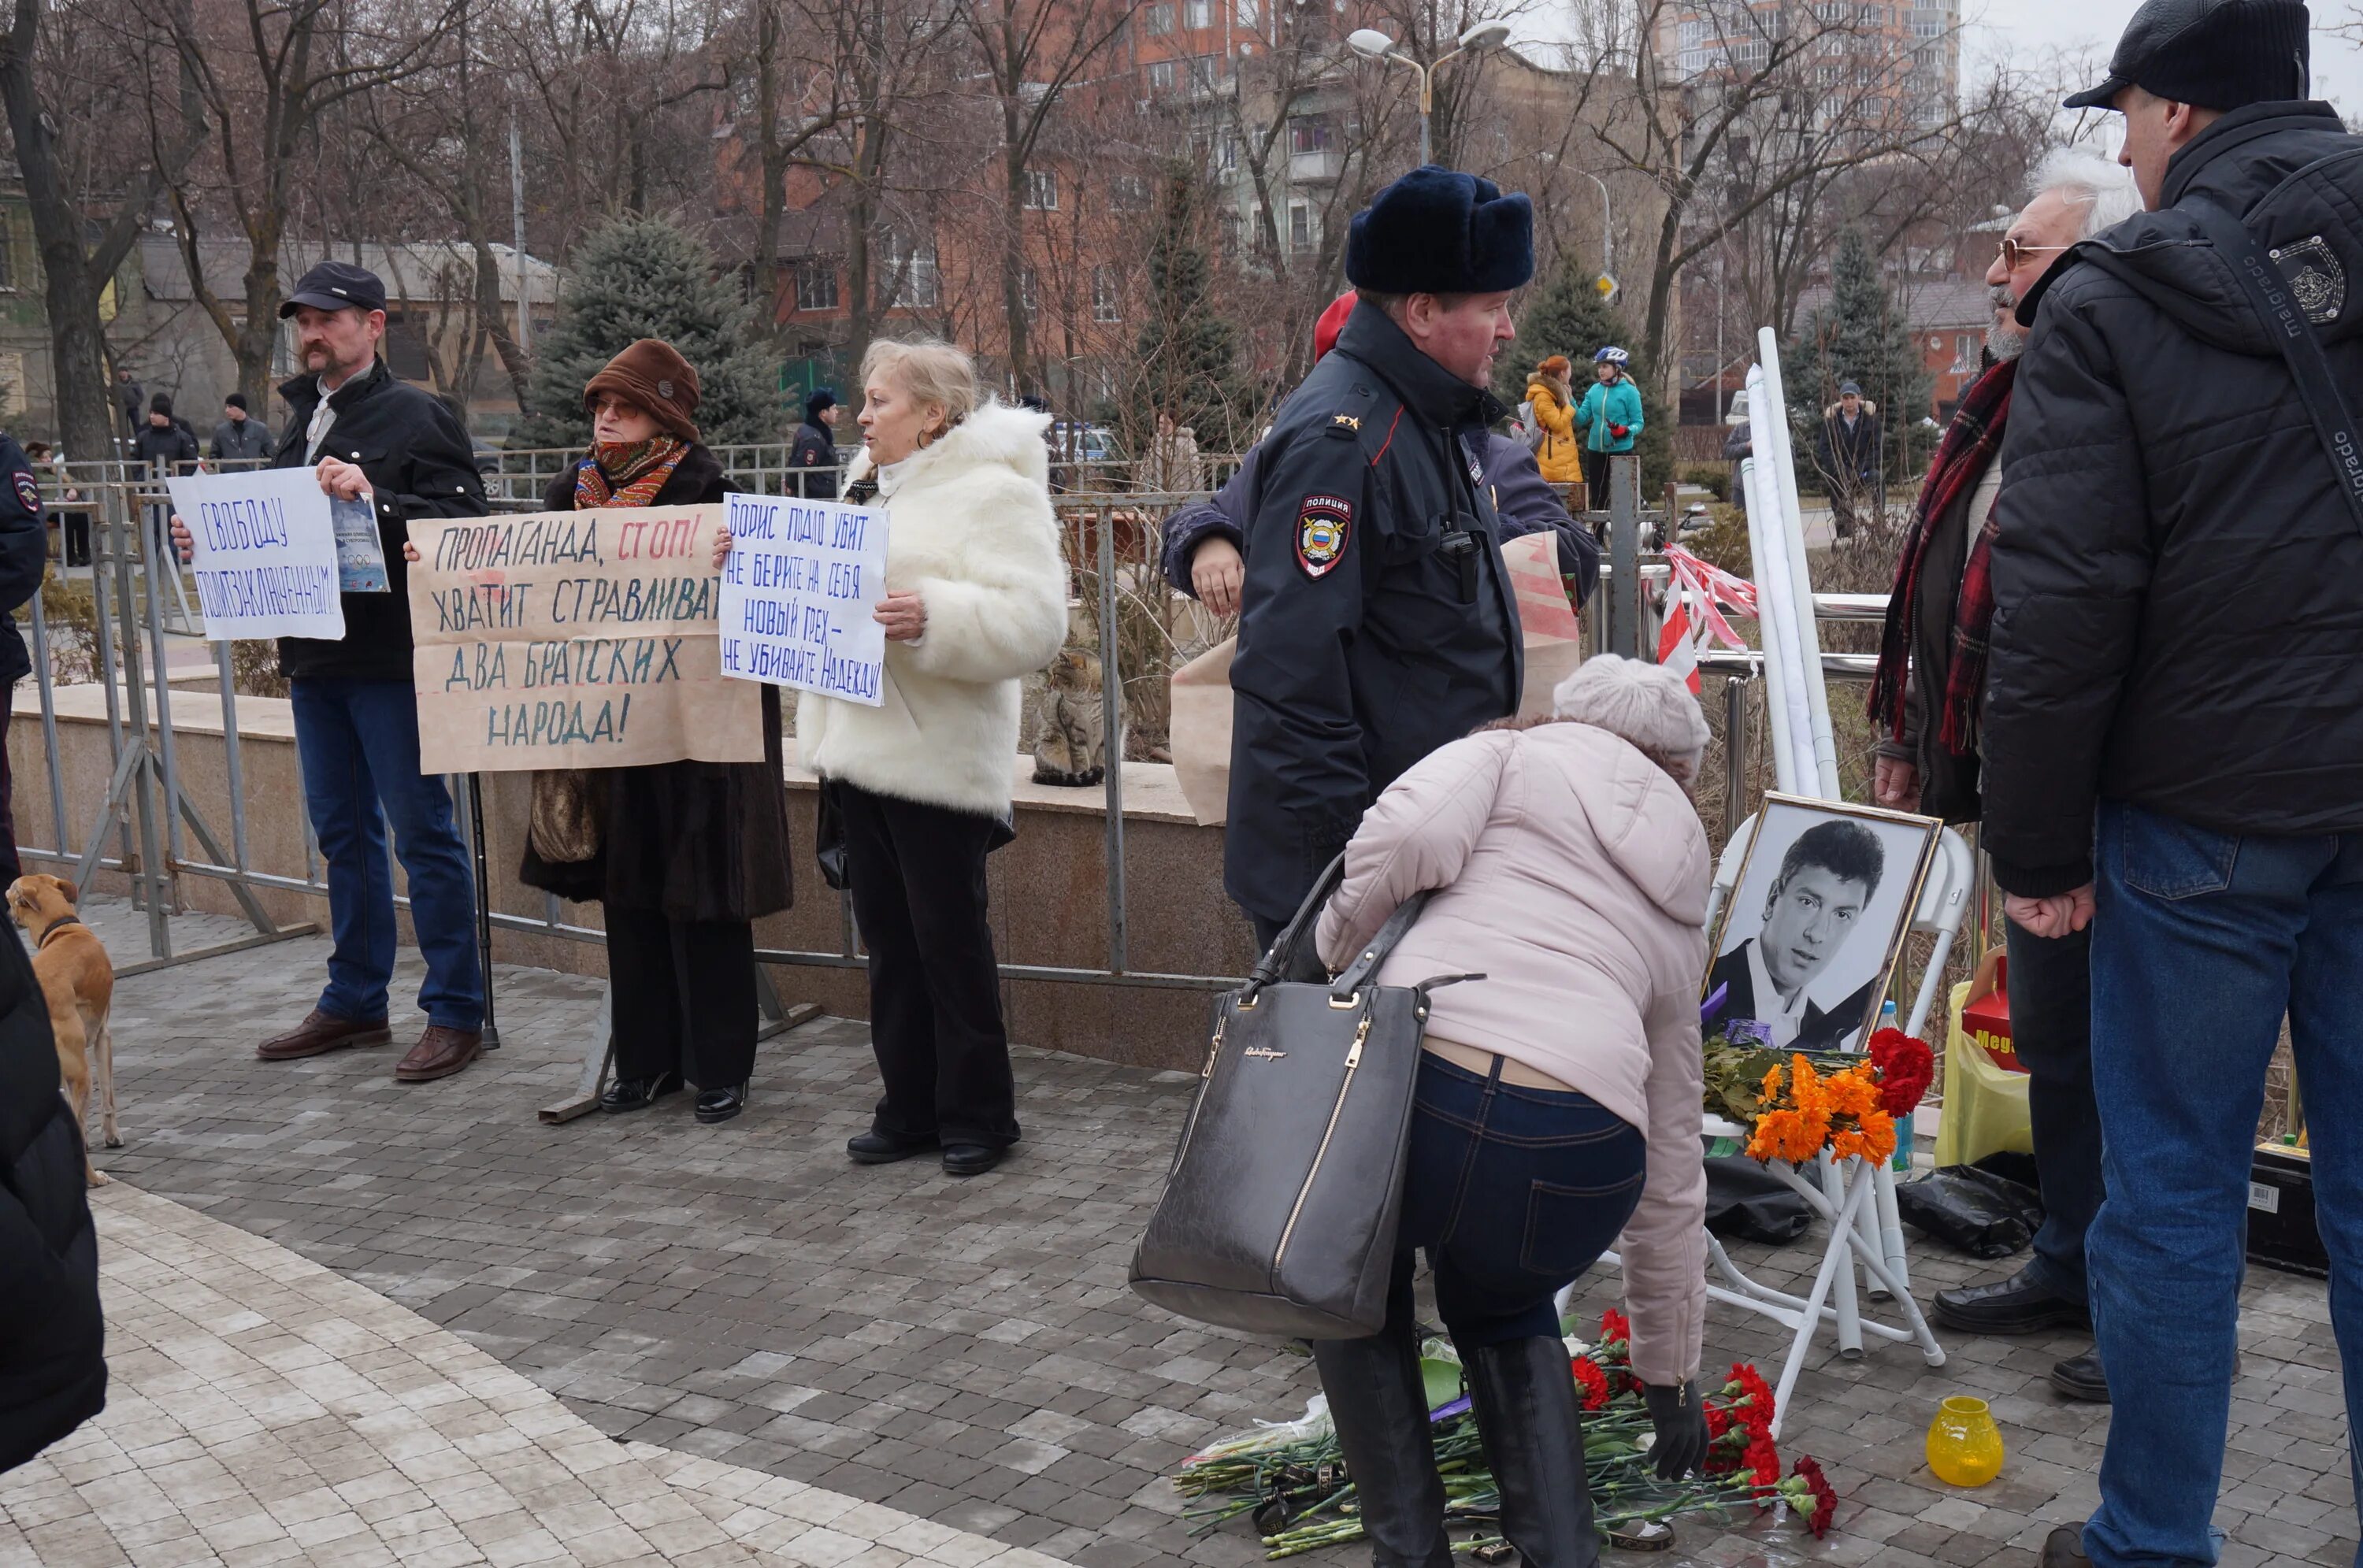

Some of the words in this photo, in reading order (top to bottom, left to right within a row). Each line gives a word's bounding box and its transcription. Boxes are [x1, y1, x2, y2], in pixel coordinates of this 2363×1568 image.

[2244, 256, 2301, 338] malgrado
[2335, 431, 2363, 502] lgrado
[201, 497, 288, 551] СВОБОДУ
[730, 495, 778, 540] БОРИС
[788, 507, 825, 546] ПОДЛО
[1306, 498, 1348, 513] ПОЛИЦИЯ
[435, 518, 604, 572] ПРОПАГАНДА,
[618, 514, 703, 561] СТОП!
[1308, 563, 1326, 576] МВД
[726, 550, 744, 585] НЕ
[754, 553, 803, 591] БЕРИТЕ
[807, 558, 819, 594] НА
[827, 562, 860, 599] СЕБЯ
[432, 583, 533, 632] ХВАТИТ
[553, 576, 721, 624] СТРАВЛИВАТ
[744, 596, 798, 639] НОВЫЙ
[445, 642, 506, 693] ДВА
[524, 638, 682, 688] БРАТСКИХ
[724, 638, 740, 671] НЕ
[748, 643, 816, 684] УБИВАЙТЕ
[821, 646, 881, 699] НАДЕЖДУ!
[487, 693, 631, 747] НАРОДА!
